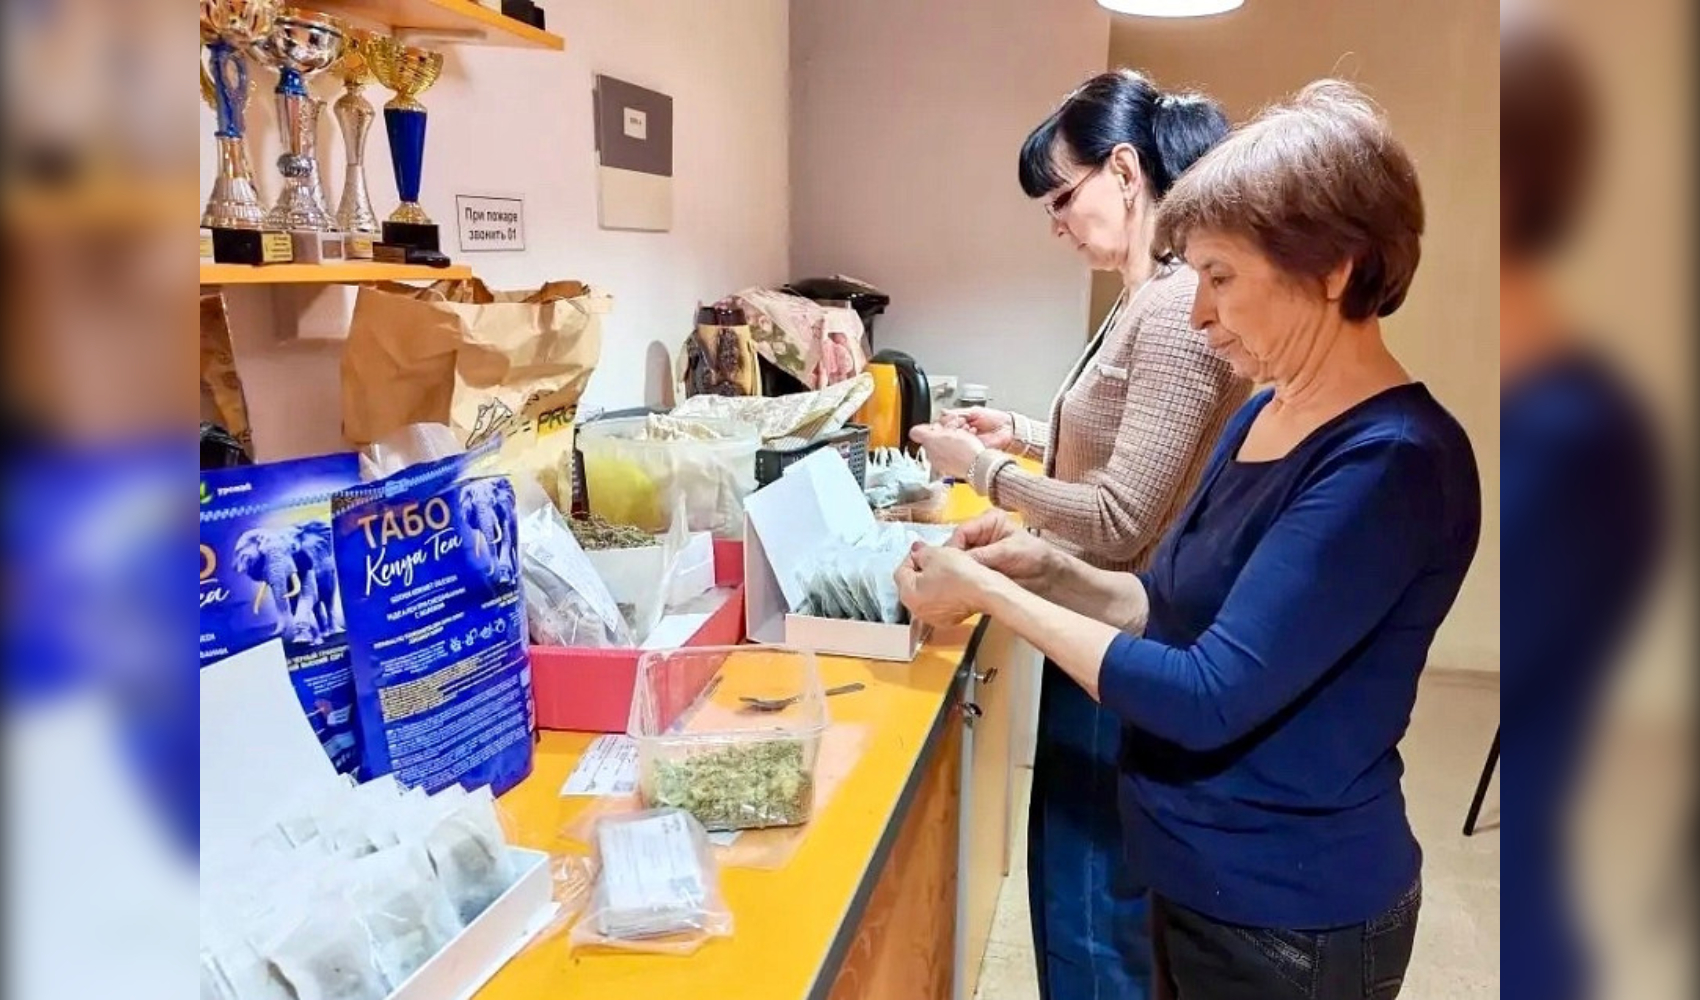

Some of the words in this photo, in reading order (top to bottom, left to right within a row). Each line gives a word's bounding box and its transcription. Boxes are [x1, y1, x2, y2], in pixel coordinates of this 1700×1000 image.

[464, 206, 485, 224] При
[486, 211, 518, 224] пожаре
[469, 230, 507, 241] звонить
[507, 227, 517, 241] 01
[358, 497, 451, 549] ТАБО
[365, 546, 428, 596] Kenya
[424, 527, 463, 561] Tea
